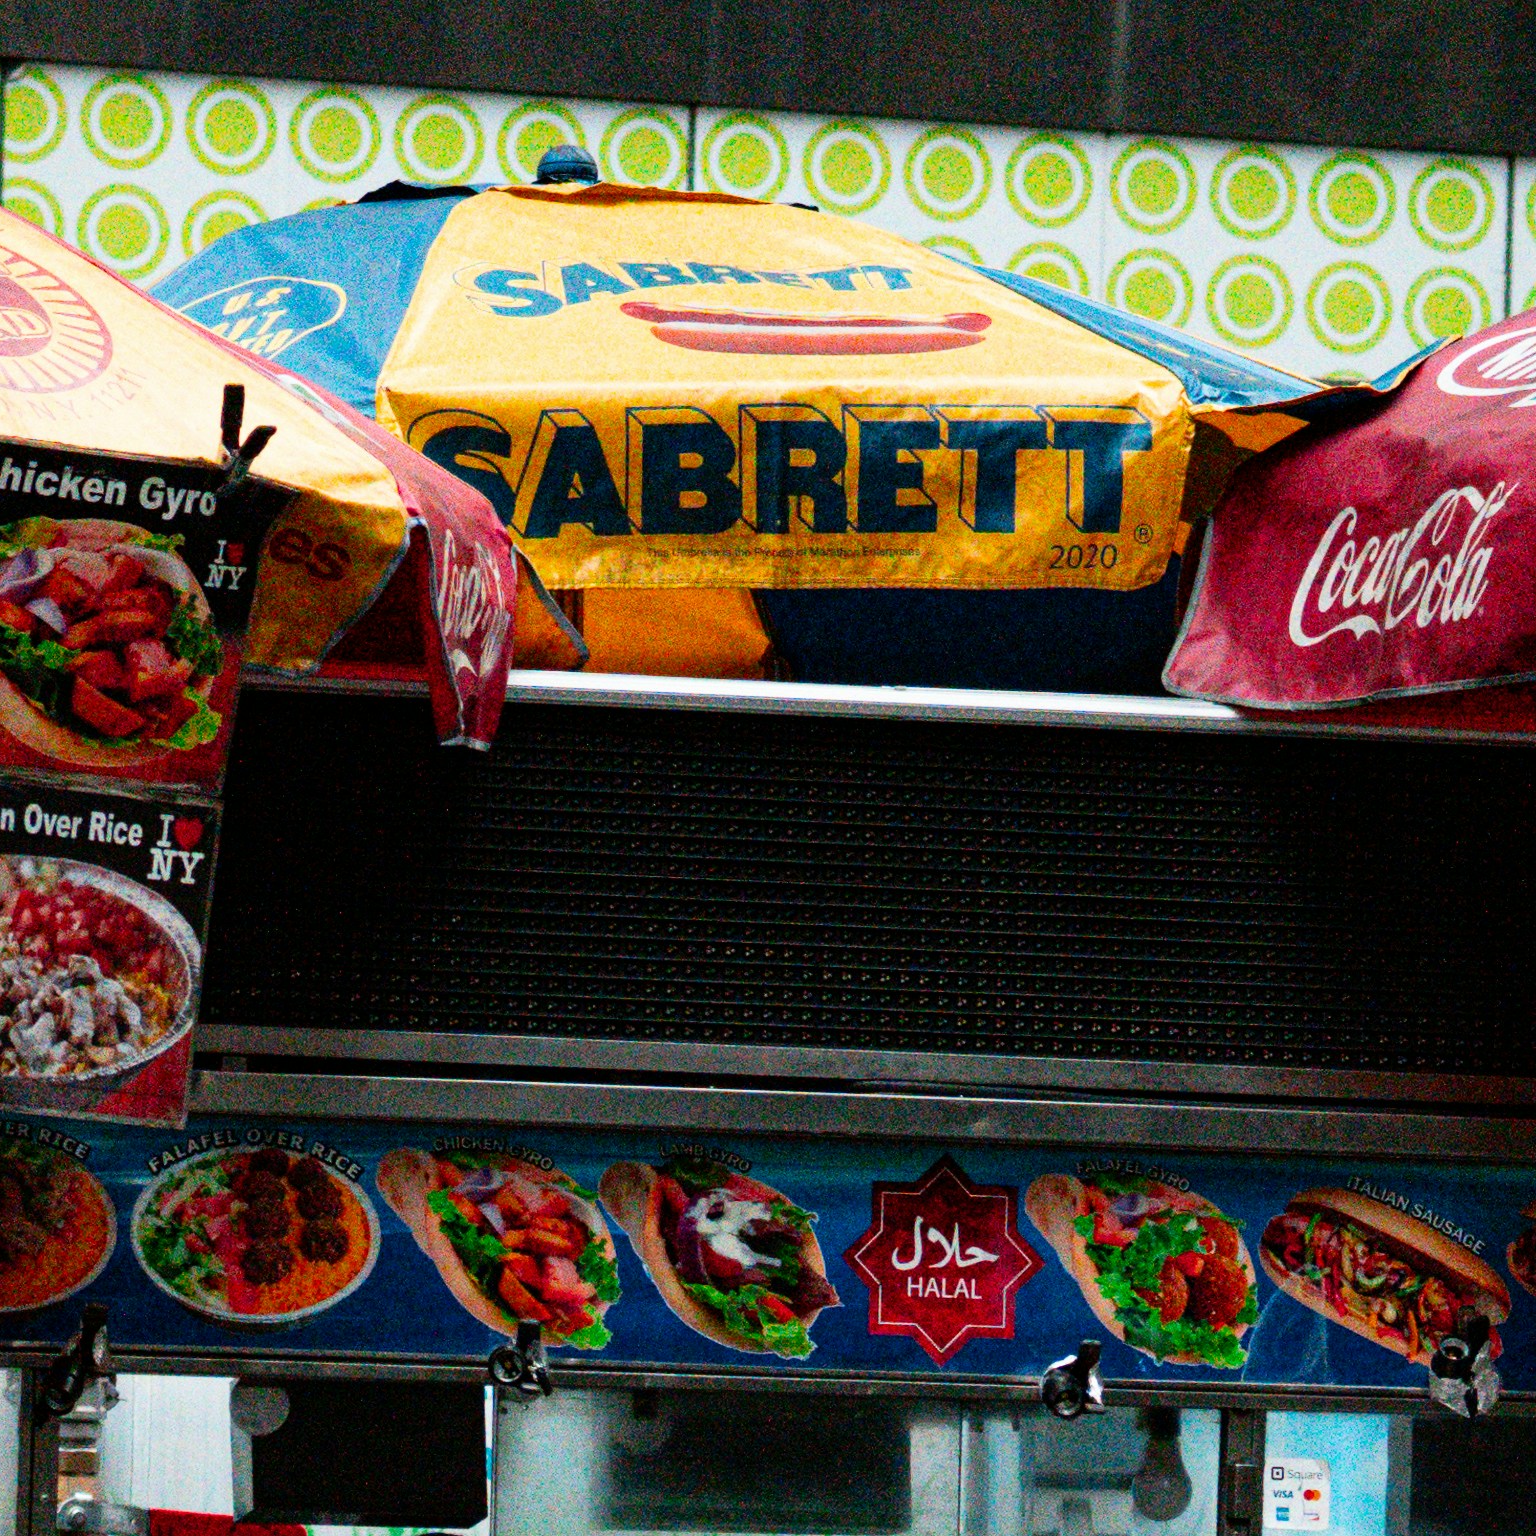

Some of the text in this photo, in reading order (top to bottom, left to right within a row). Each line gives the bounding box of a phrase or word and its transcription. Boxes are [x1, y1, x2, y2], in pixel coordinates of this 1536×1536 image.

[464, 260, 914, 318] SABRETT
[407, 400, 1154, 538] SABRETT
[139, 475, 217, 520] Gyro
[1049, 543, 1118, 571] 2020
[204, 563, 247, 591] NY
[24, 803, 80, 840] Over
[88, 813, 144, 848] Rice
[156, 813, 173, 849] I
[147, 847, 206, 885] NY
[36, 1128, 92, 1162] RICE
[147, 1128, 364, 1181] FALAFEL OVER RICE
[432, 1134, 555, 1172] CHICKEN GYRO
[660, 1142, 755, 1174] LAMB GYRO
[1074, 1159, 1192, 1194] FALAFEL GYRO
[1346, 1173, 1486, 1257] ITALIAN SAUSAGE
[891, 1214, 1001, 1273] حلال
[906, 1276, 983, 1301] HALAL
[1287, 1469, 1324, 1484] Square
